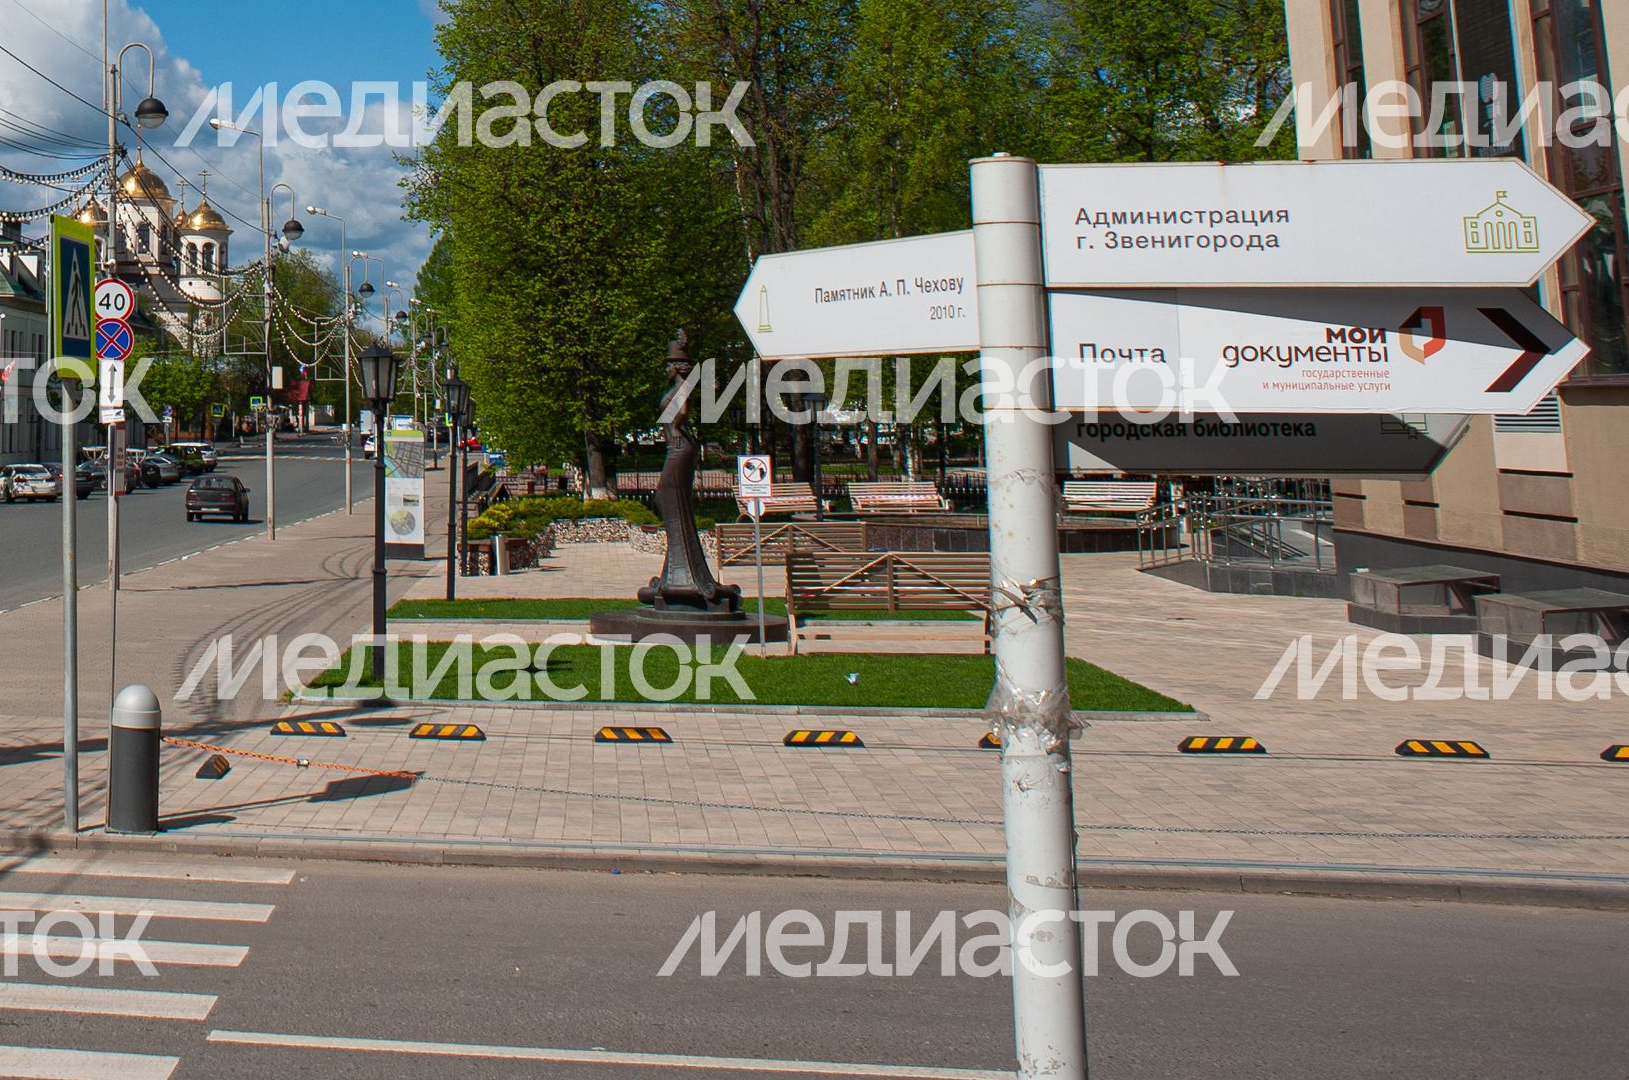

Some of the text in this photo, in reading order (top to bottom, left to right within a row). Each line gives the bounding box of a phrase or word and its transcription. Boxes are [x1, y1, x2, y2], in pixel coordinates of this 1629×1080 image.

[1075, 207, 1290, 228] Администрация
[1076, 231, 1280, 252] г. Звенигорода
[814, 276, 964, 304] Памятник А. П. Чехову
[98, 292, 126, 311] 40
[929, 304, 966, 320] 2010 г.
[1325, 327, 1387, 344] мои
[1078, 342, 1167, 363] Почта
[1222, 345, 1389, 369] документы
[1302, 370, 1390, 380] государственные
[1262, 381, 1391, 392] и муниципальные услуги
[1076, 417, 1317, 442] городская библиотека
